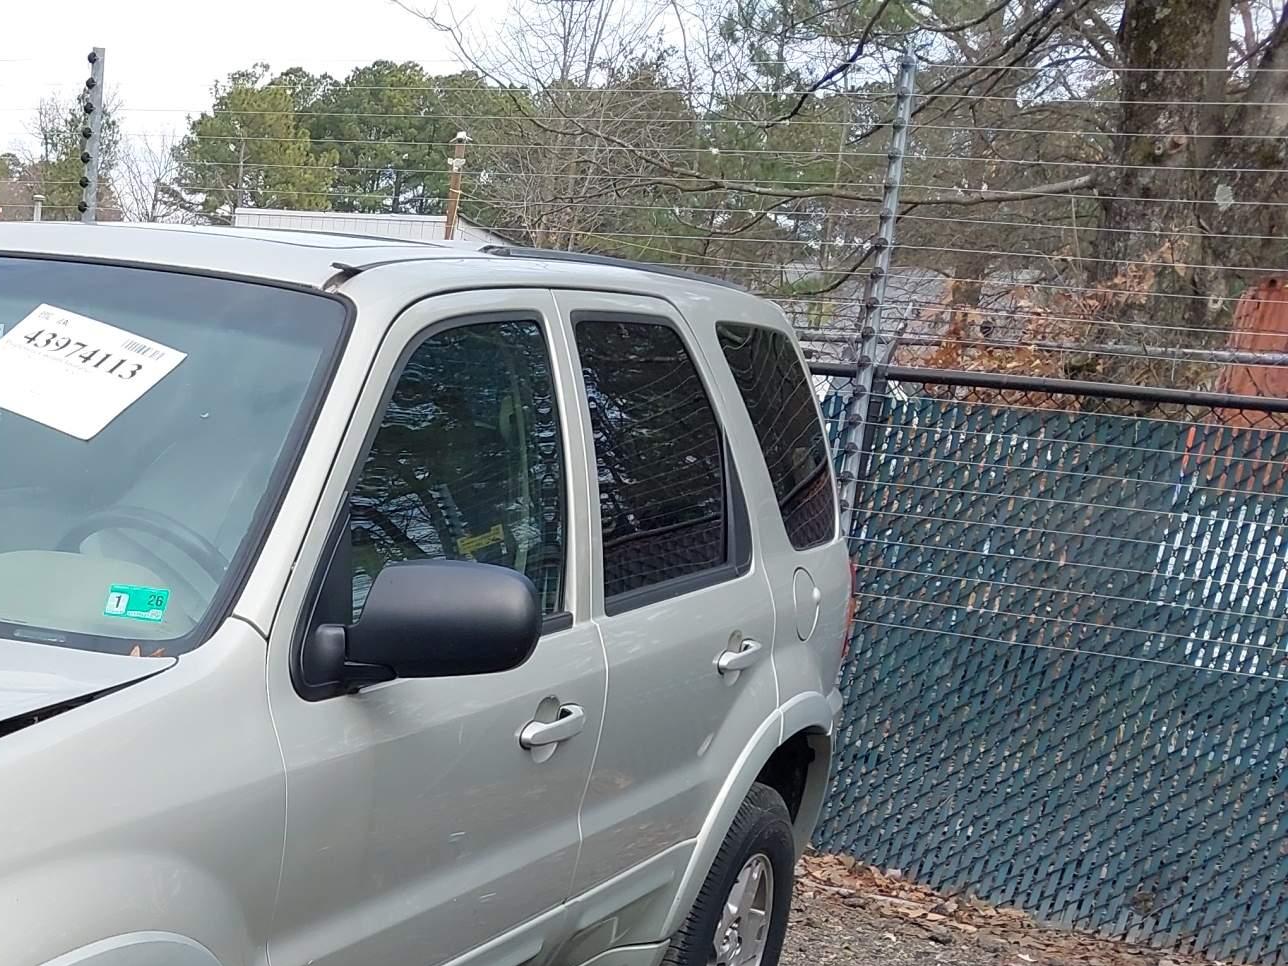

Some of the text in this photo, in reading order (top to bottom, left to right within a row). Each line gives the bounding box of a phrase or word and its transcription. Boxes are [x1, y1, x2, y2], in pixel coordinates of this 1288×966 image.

[23, 329, 143, 380] 43974113
[114, 594, 165, 609] 1 26
